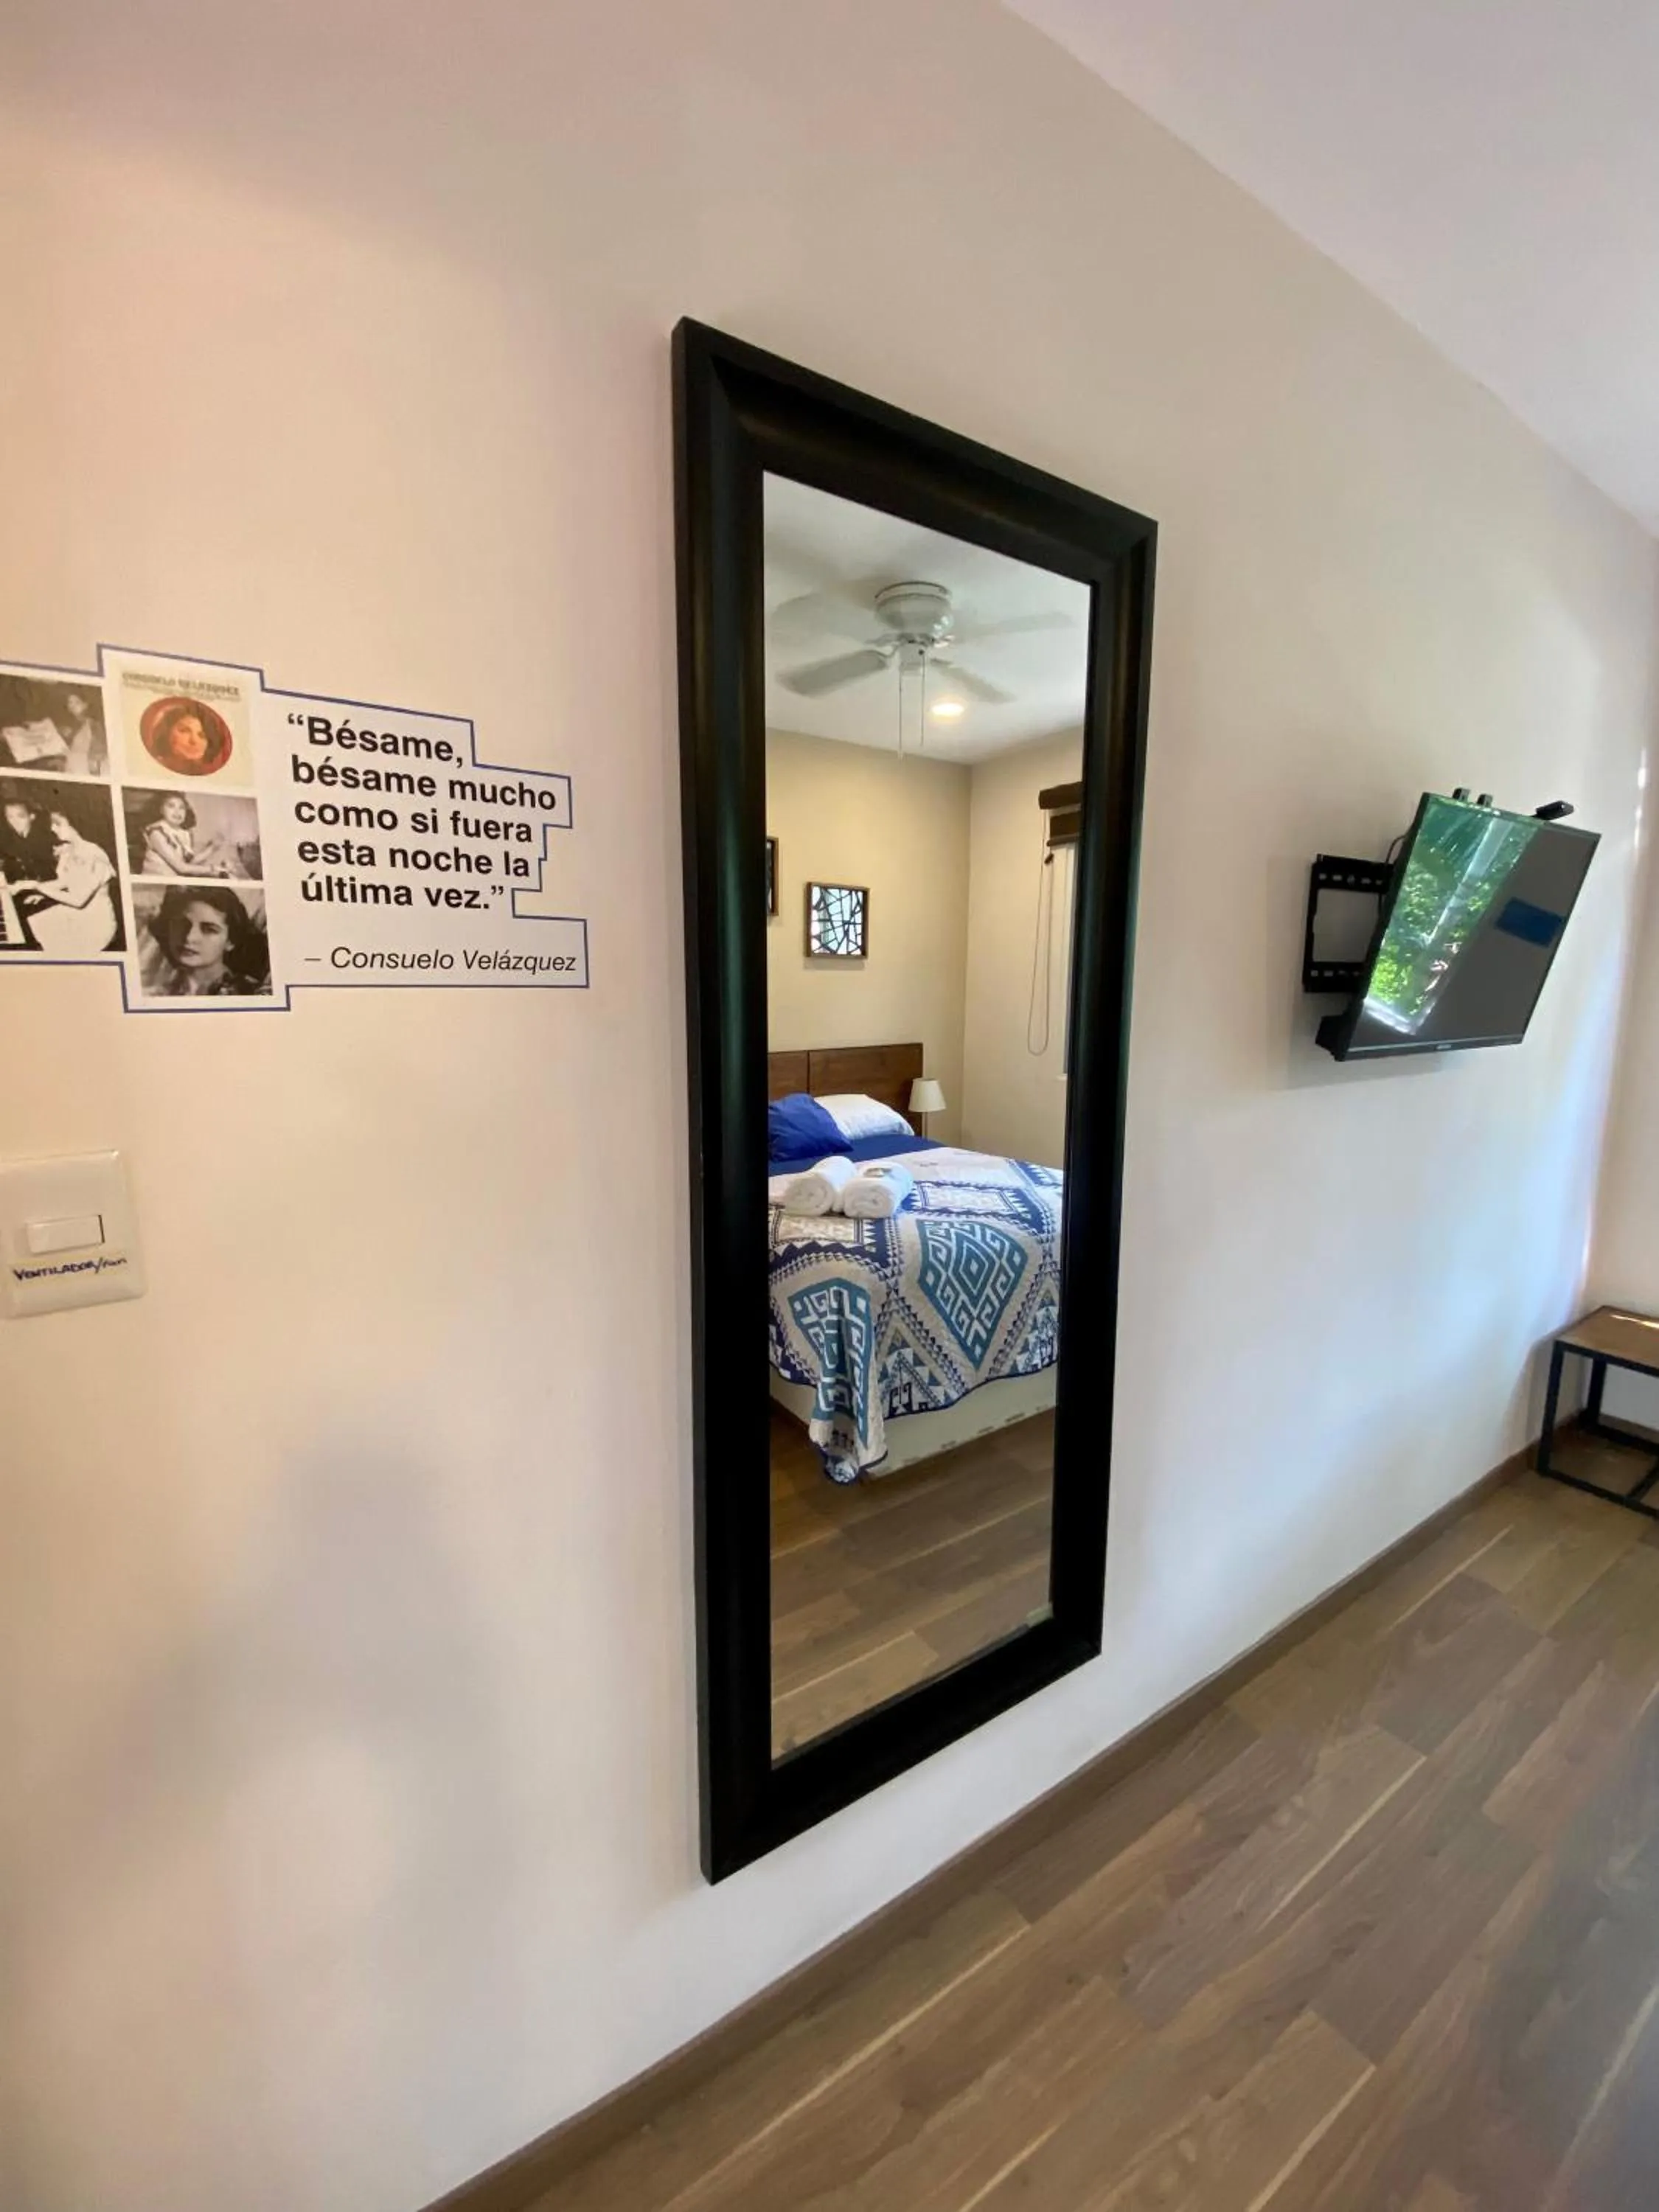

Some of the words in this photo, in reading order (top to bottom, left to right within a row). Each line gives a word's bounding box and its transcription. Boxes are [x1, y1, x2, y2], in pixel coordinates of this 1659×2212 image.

[287, 712, 463, 769] “Bésame,
[291, 753, 437, 798] bésame
[448, 779, 557, 811] mucho
[294, 801, 399, 832] como
[410, 807, 439, 835] si
[449, 810, 533, 843] fuera
[297, 838, 377, 867] esta
[389, 846, 493, 875] noche
[504, 850, 530, 878] la
[300, 872, 414, 906] última
[423, 884, 504, 910] vez.”
[330, 946, 455, 970] Consuelo
[462, 949, 577, 975] Velázquez
